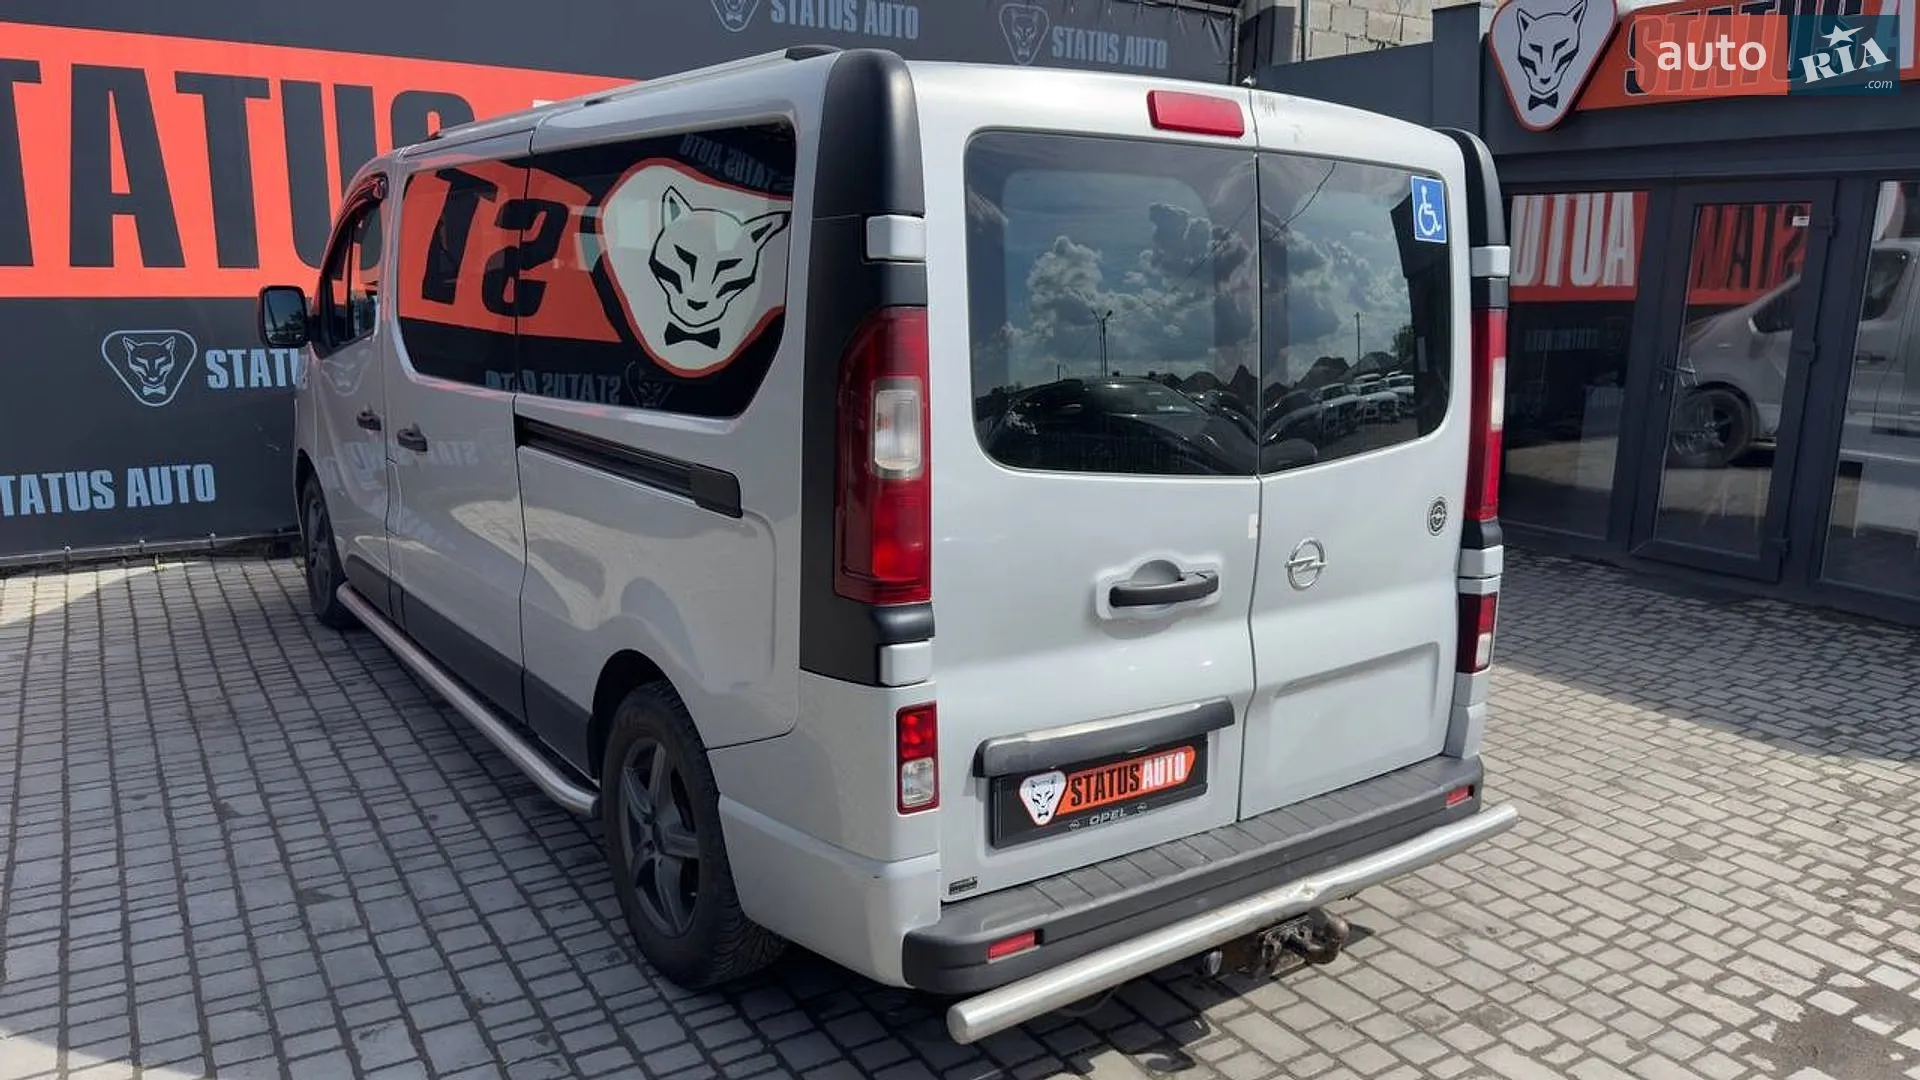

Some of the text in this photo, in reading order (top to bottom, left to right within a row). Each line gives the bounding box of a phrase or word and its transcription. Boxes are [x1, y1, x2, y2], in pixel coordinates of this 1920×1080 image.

[770, 0, 919, 40] STATUS AUTO
[1052, 25, 1168, 69] STATUS AUTO
[126, 463, 216, 508] AUTO
[1071, 751, 1185, 806] STATUS AUTO
[1089, 808, 1127, 825] OPEL
